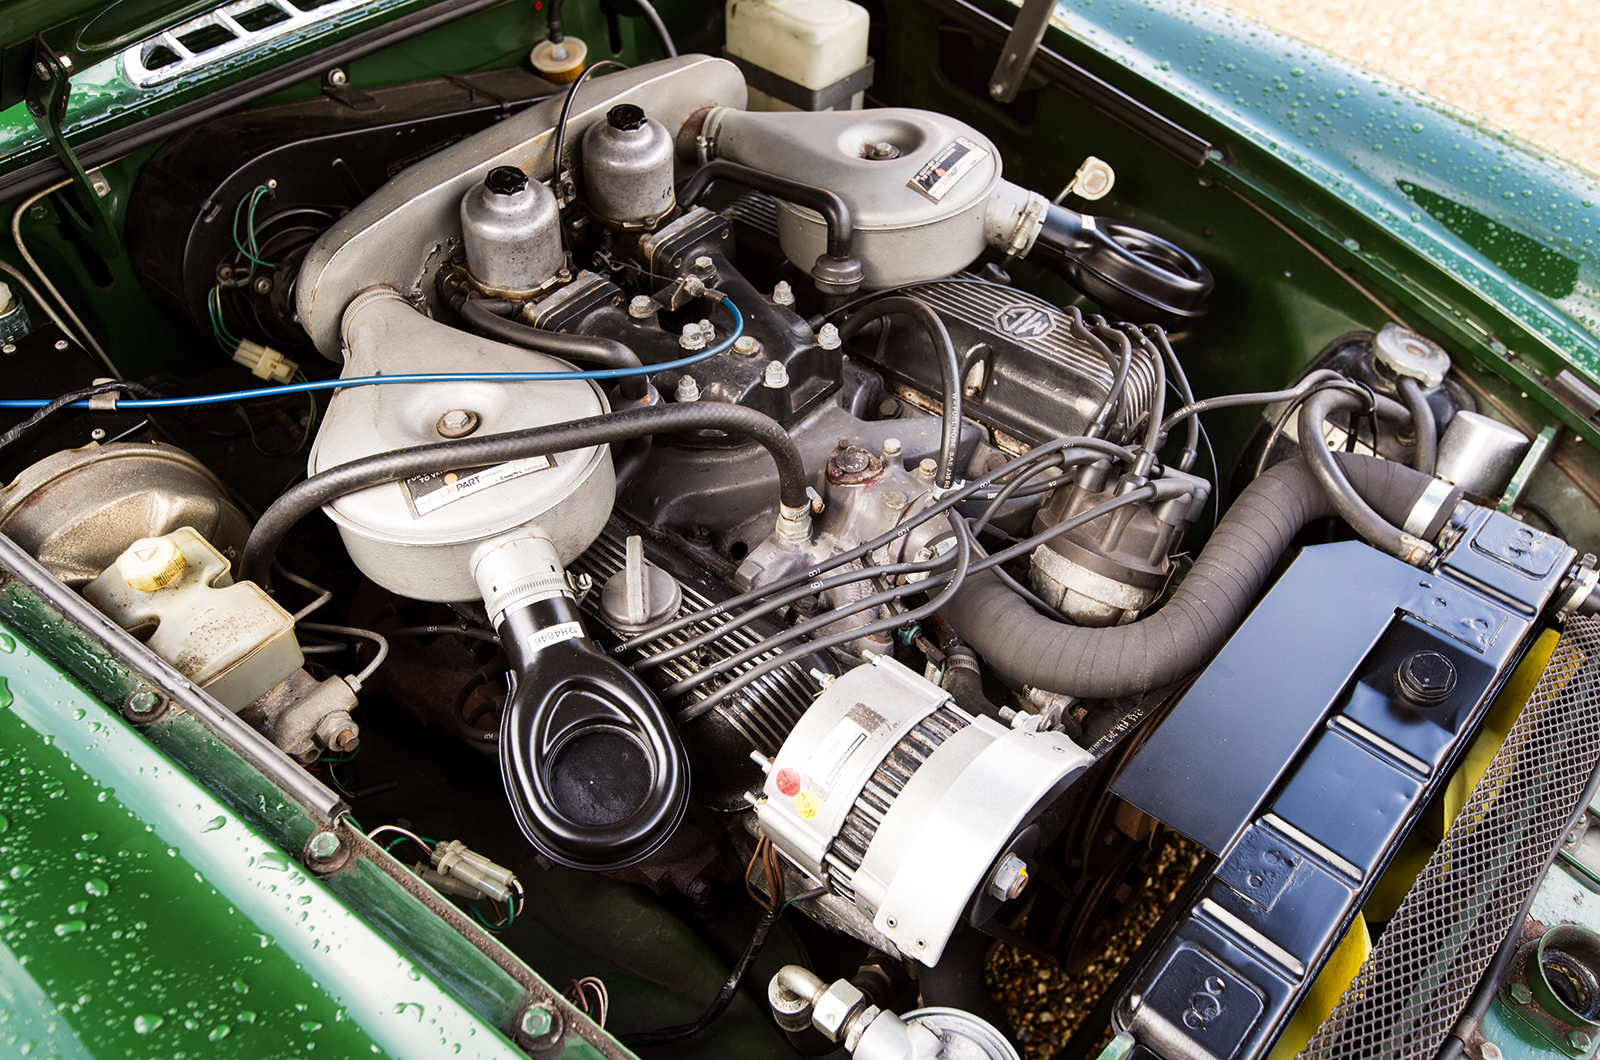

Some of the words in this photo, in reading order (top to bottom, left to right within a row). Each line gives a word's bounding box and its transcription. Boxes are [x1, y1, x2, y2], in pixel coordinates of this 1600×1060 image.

[1000, 307, 1050, 337] MG
[1173, 406, 1190, 419] LEAD
[950, 426, 958, 449] HOSE
[947, 450, 955, 467] SAE
[418, 475, 431, 484] TO
[439, 475, 481, 499] UNIPART
[533, 626, 578, 646] 12H4846
[782, 782, 799, 795] TESTED
[803, 808, 816, 819] QC
